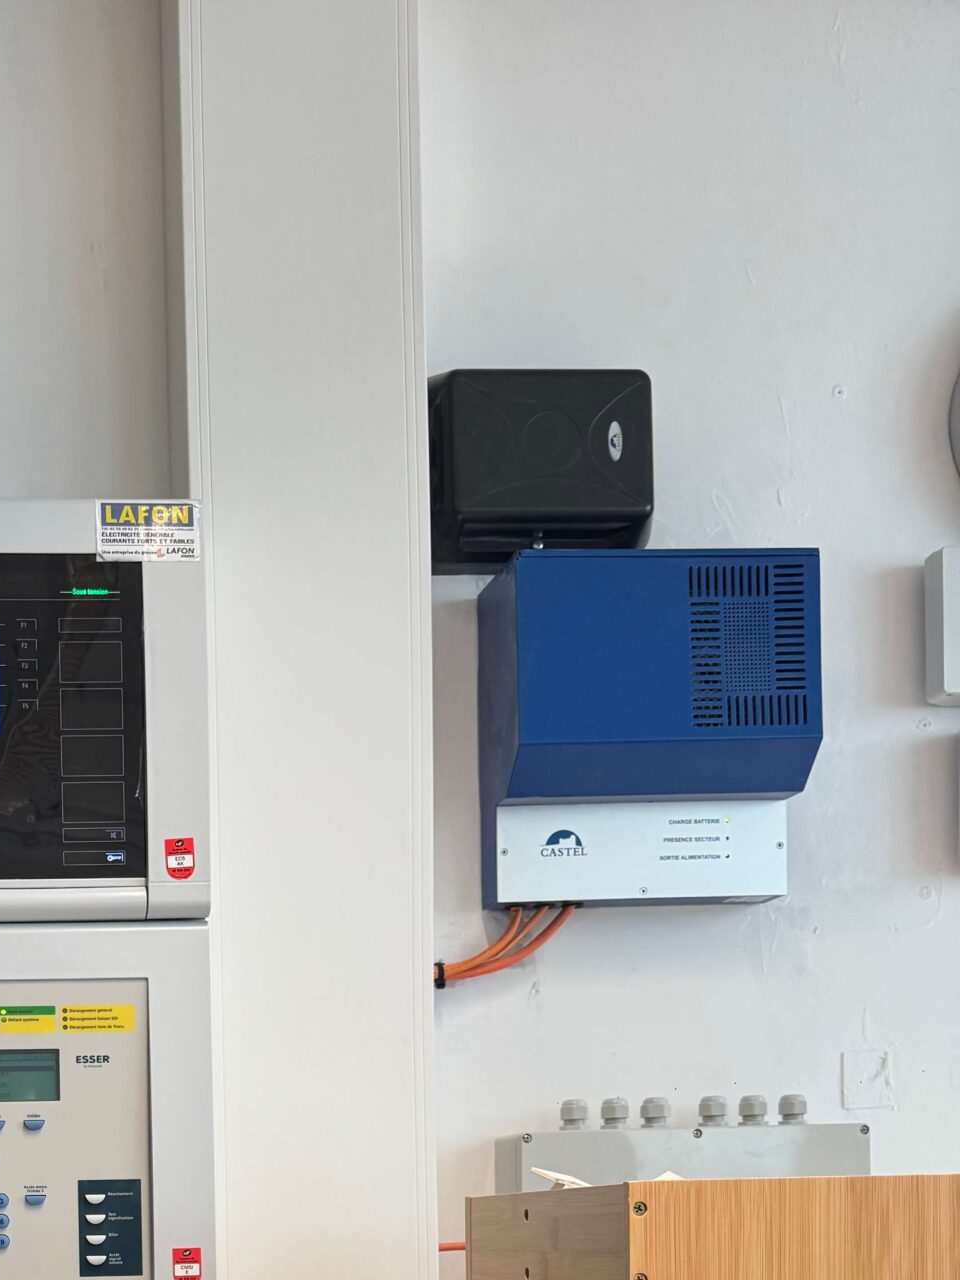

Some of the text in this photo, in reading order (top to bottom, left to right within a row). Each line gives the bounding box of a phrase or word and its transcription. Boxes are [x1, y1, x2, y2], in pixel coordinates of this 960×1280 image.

[105, 505, 189, 524] LAFON
[541, 847, 588, 857] CASTEL
[76, 1055, 110, 1064] ESSER
